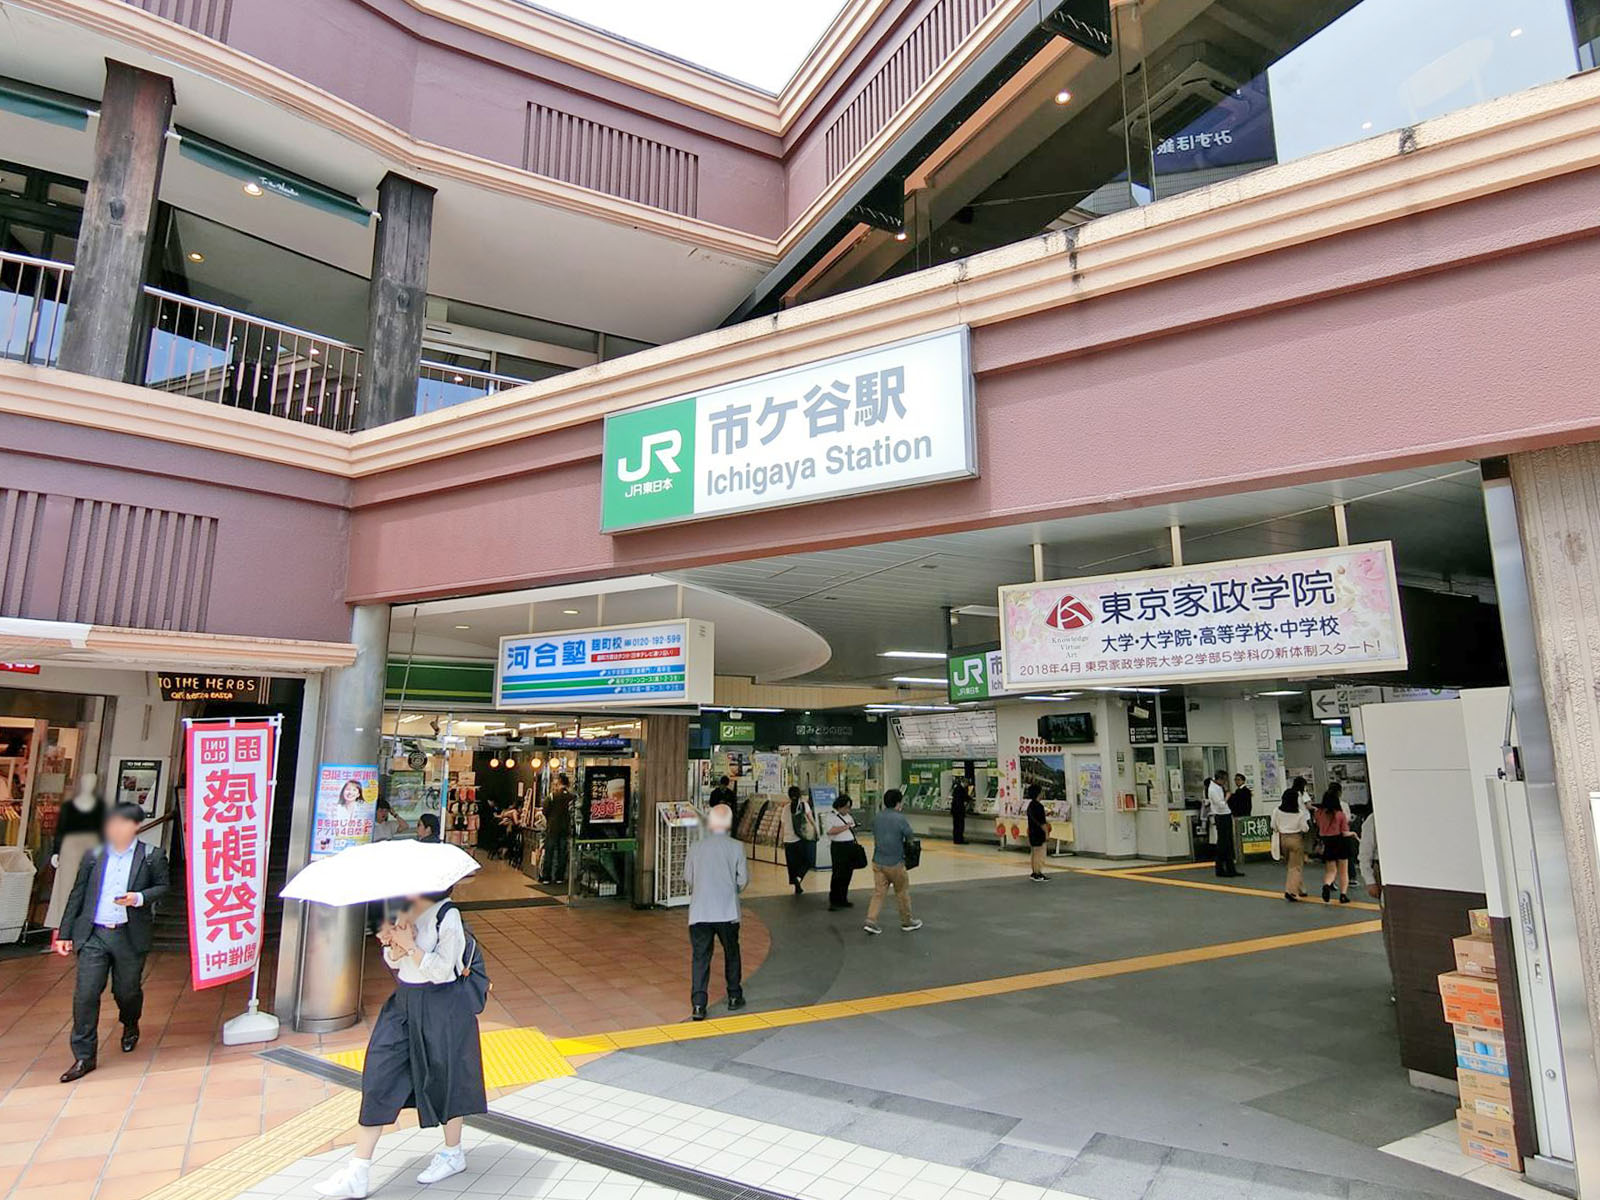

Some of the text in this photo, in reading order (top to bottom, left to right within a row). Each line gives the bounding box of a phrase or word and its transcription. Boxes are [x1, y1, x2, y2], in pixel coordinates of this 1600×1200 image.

[708, 365, 907, 456] 市ケ谷駅
[617, 429, 682, 482] JR
[707, 434, 932, 496] Ichigaya Station
[625, 478, 674, 498] JR東日本
[1099, 570, 1335, 625] 東京家政学院
[507, 640, 586, 670] 河合塾
[1020, 662, 1081, 676] 2018年4月
[175, 677, 199, 690] THE
[206, 678, 256, 691] HERBS
[953, 658, 984, 687] JR
[1240, 816, 1269, 837] JR線
